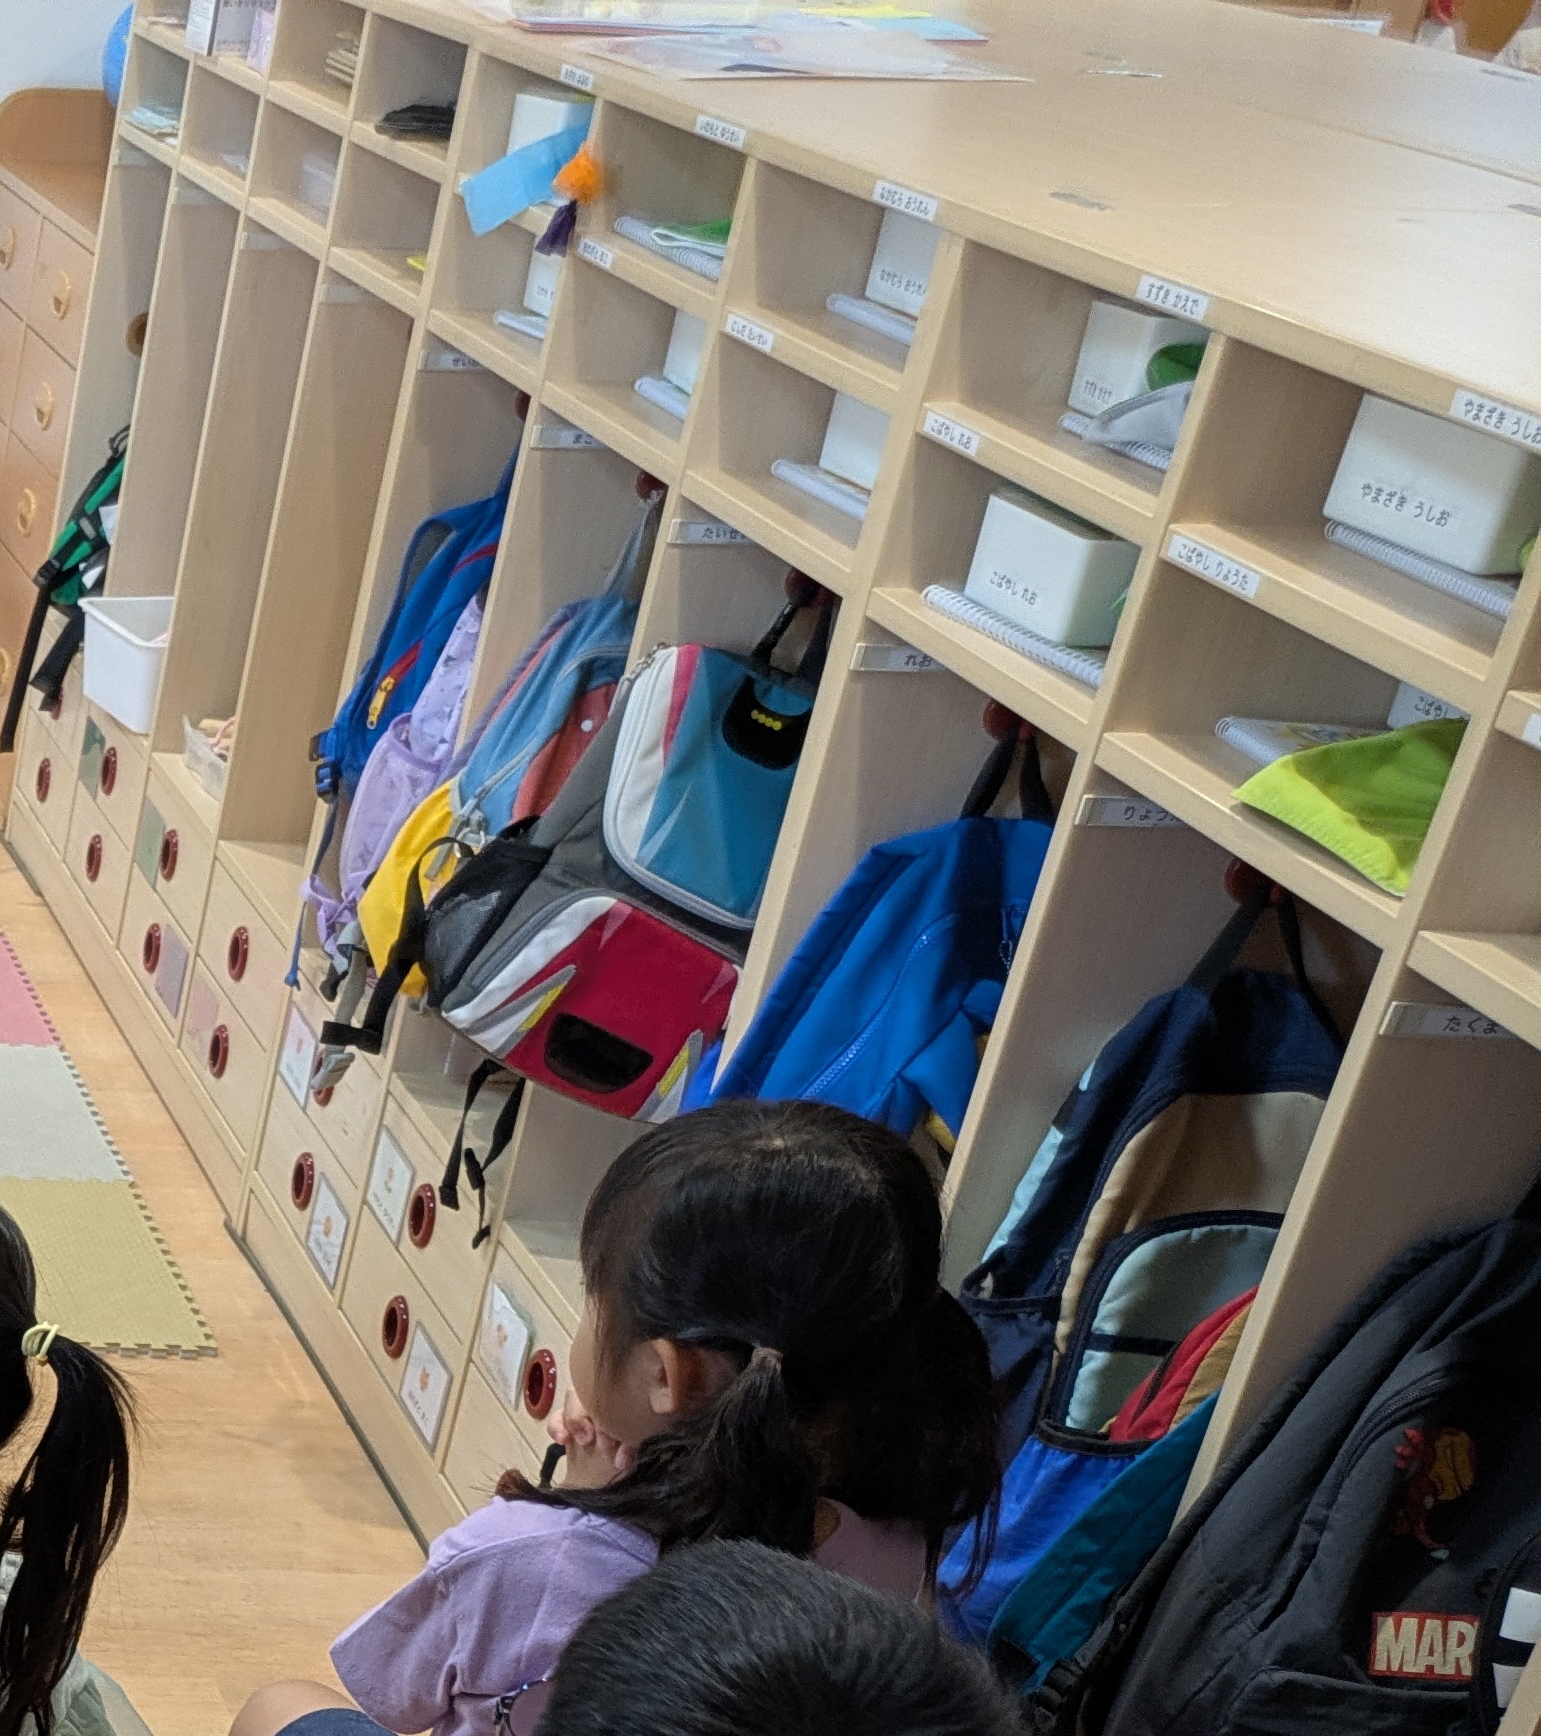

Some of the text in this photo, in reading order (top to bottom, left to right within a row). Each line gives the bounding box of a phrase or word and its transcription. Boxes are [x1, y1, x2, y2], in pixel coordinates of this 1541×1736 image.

[930, 418, 955, 442] こばやし
[1464, 399, 1506, 430] やまざき
[1361, 483, 1451, 527] やまざき うしお
[1178, 544, 1249, 591] こばやし りょうた
[990, 571, 1037, 606] こばやし れお
[904, 654, 932, 668] れお
[1123, 806, 1176, 822] りょう
[1443, 1015, 1499, 1035] たくま
[1374, 1616, 1478, 1676] MAR
